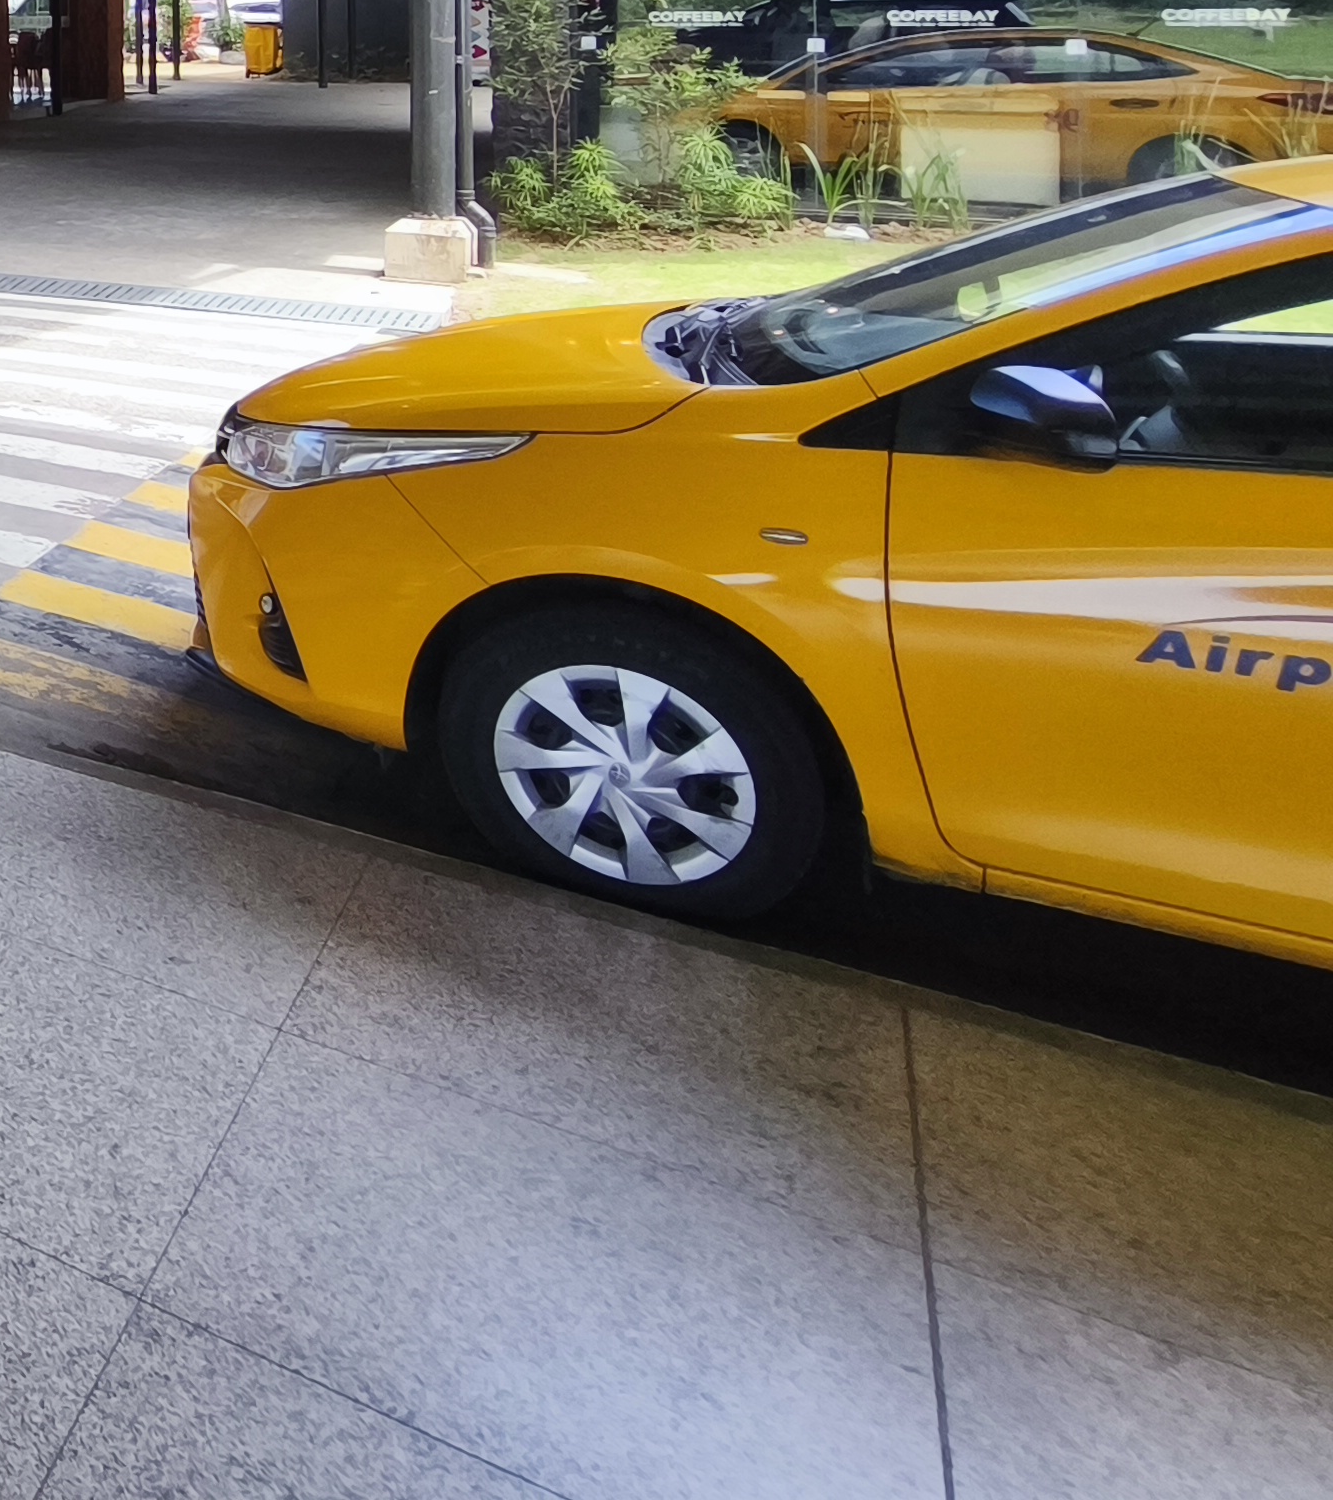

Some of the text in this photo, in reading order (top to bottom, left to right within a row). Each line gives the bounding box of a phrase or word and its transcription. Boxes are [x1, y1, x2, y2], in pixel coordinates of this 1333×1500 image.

[648, 10, 746, 23] COFFEEBAY
[1161, 7, 1292, 22] COFFEEBAY
[1136, 630, 1332, 693] Airp
